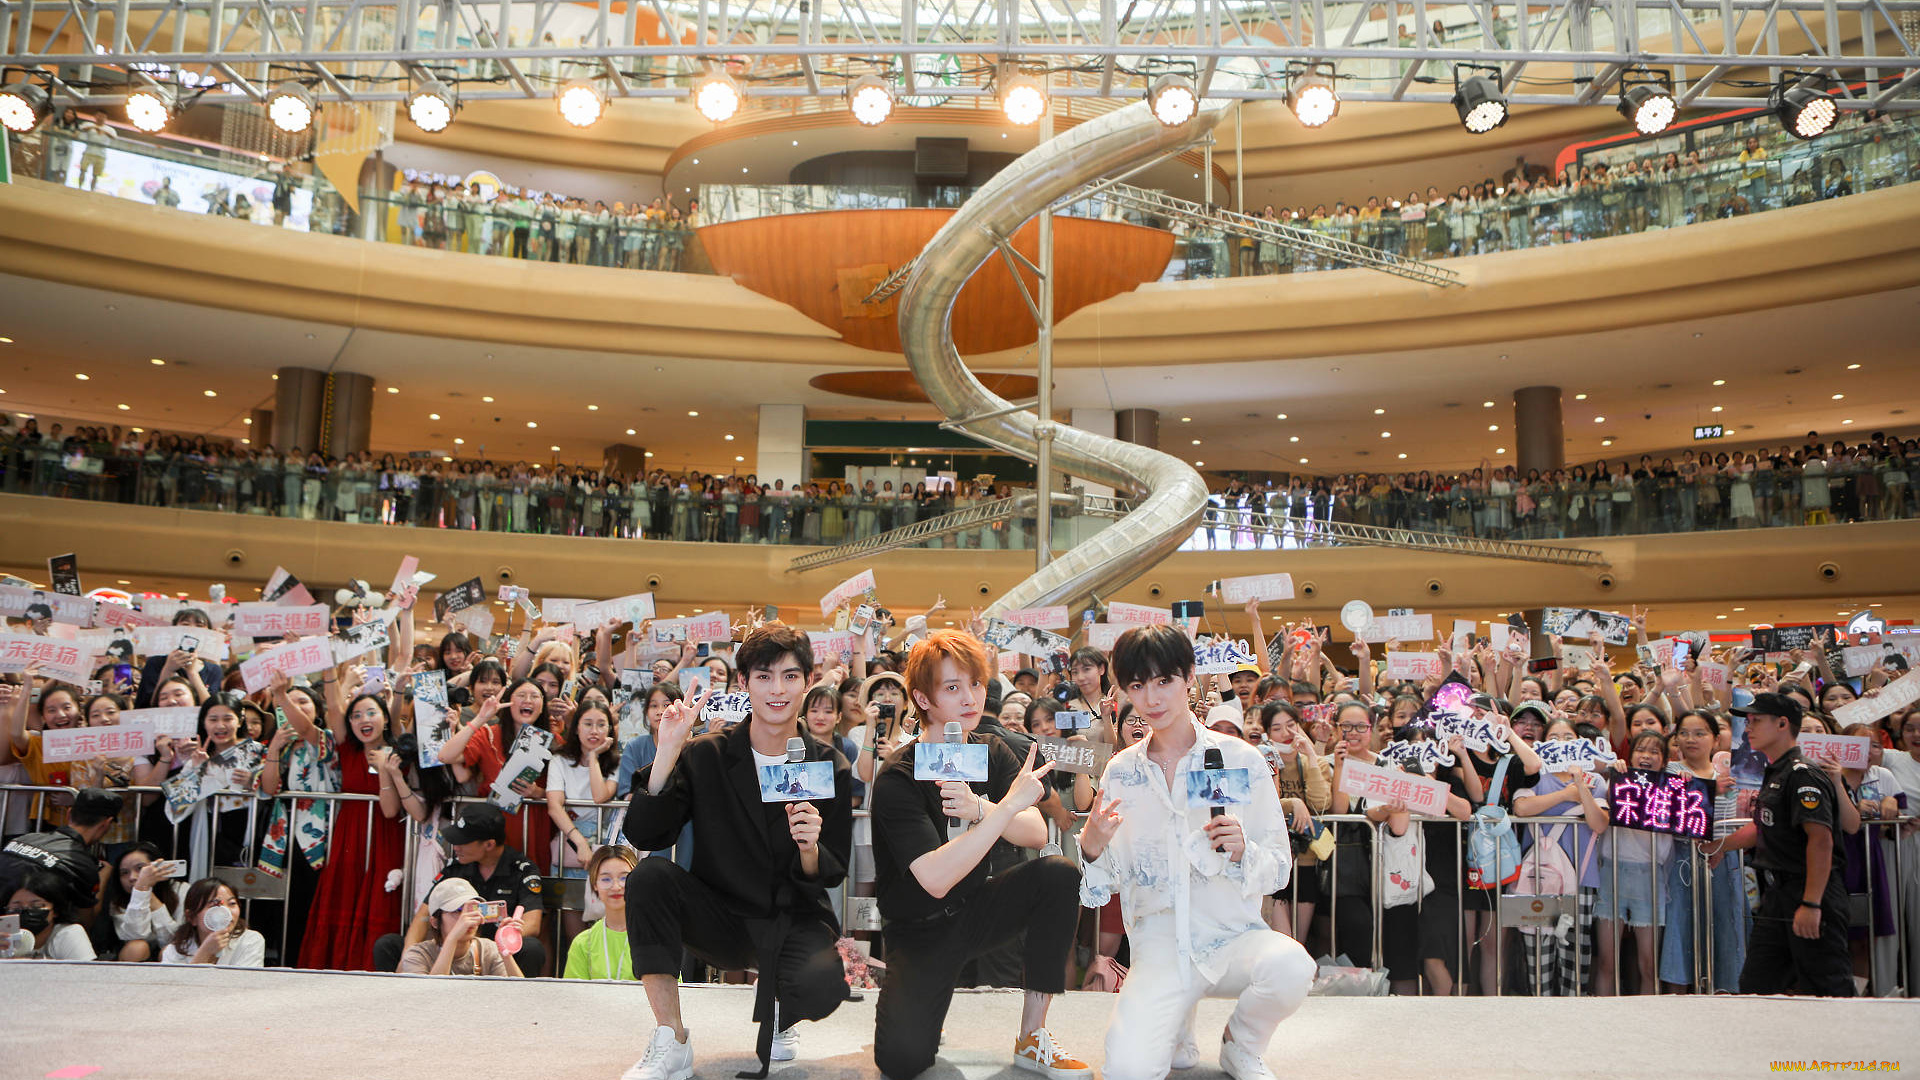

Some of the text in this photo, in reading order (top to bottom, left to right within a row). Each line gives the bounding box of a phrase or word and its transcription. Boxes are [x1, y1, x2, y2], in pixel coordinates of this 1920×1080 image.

[264, 612, 322, 631] 宋继扬
[688, 620, 723, 639] 继扬
[6, 640, 80, 665] 宋继扬
[261, 644, 321, 678] 宋继扬
[1431, 710, 1509, 750] 陈情令
[75, 731, 144, 755] 宋继扬
[1535, 740, 1616, 765] 陈情令
[1803, 740, 1862, 763] 宋继扬
[1368, 773, 1435, 806] 宋继扬
[1613, 776, 1708, 837] 宋继扬
